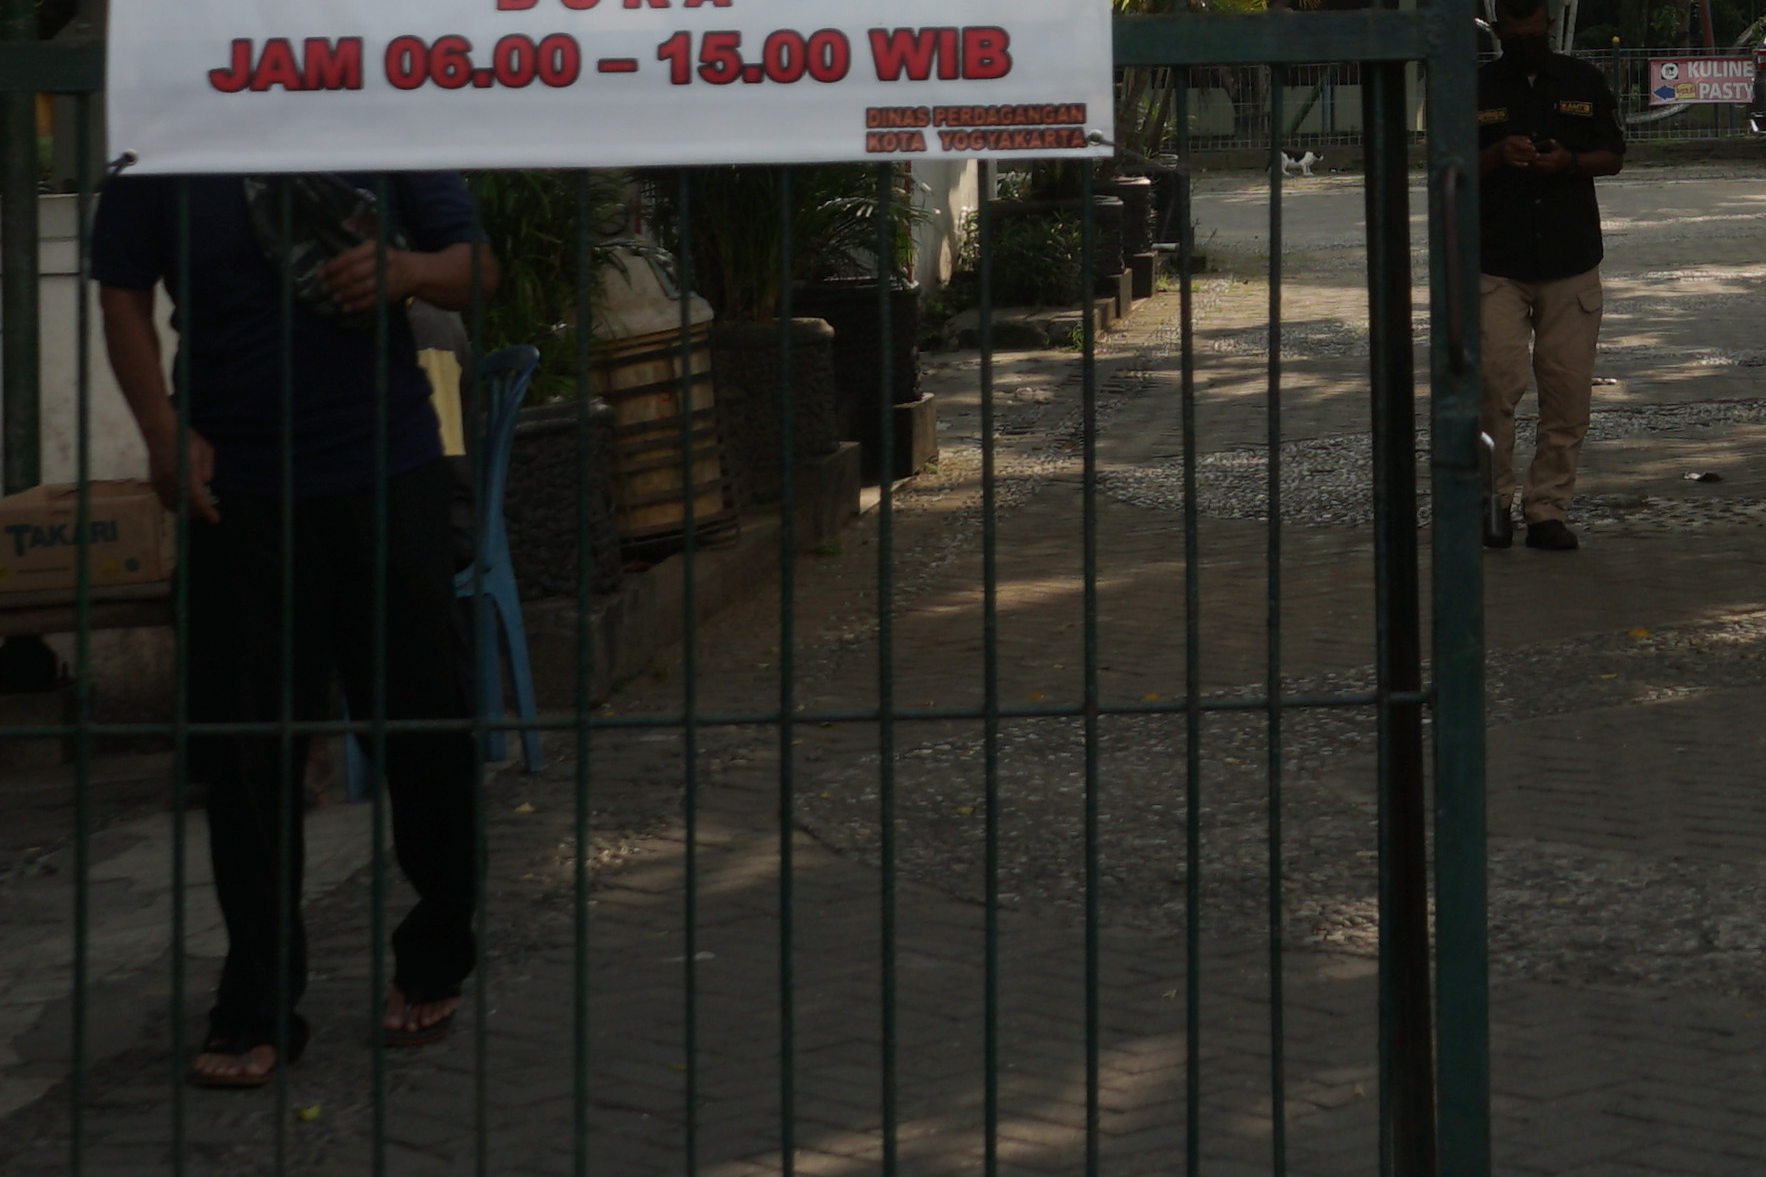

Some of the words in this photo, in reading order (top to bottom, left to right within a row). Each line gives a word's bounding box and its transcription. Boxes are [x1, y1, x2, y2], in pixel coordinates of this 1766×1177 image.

[208, 36, 364, 94] JAM
[384, 32, 582, 90] 06.00
[656, 28, 851, 86] 15.00
[867, 26, 1013, 82] WIB
[1687, 60, 1755, 79] KULINE
[1699, 82, 1754, 100] PASTY
[866, 106, 931, 128] DINAS
[932, 103, 1087, 127] PERDAGANGAN
[866, 130, 927, 153] KOTA
[937, 127, 1088, 152] YOGYAKARTA
